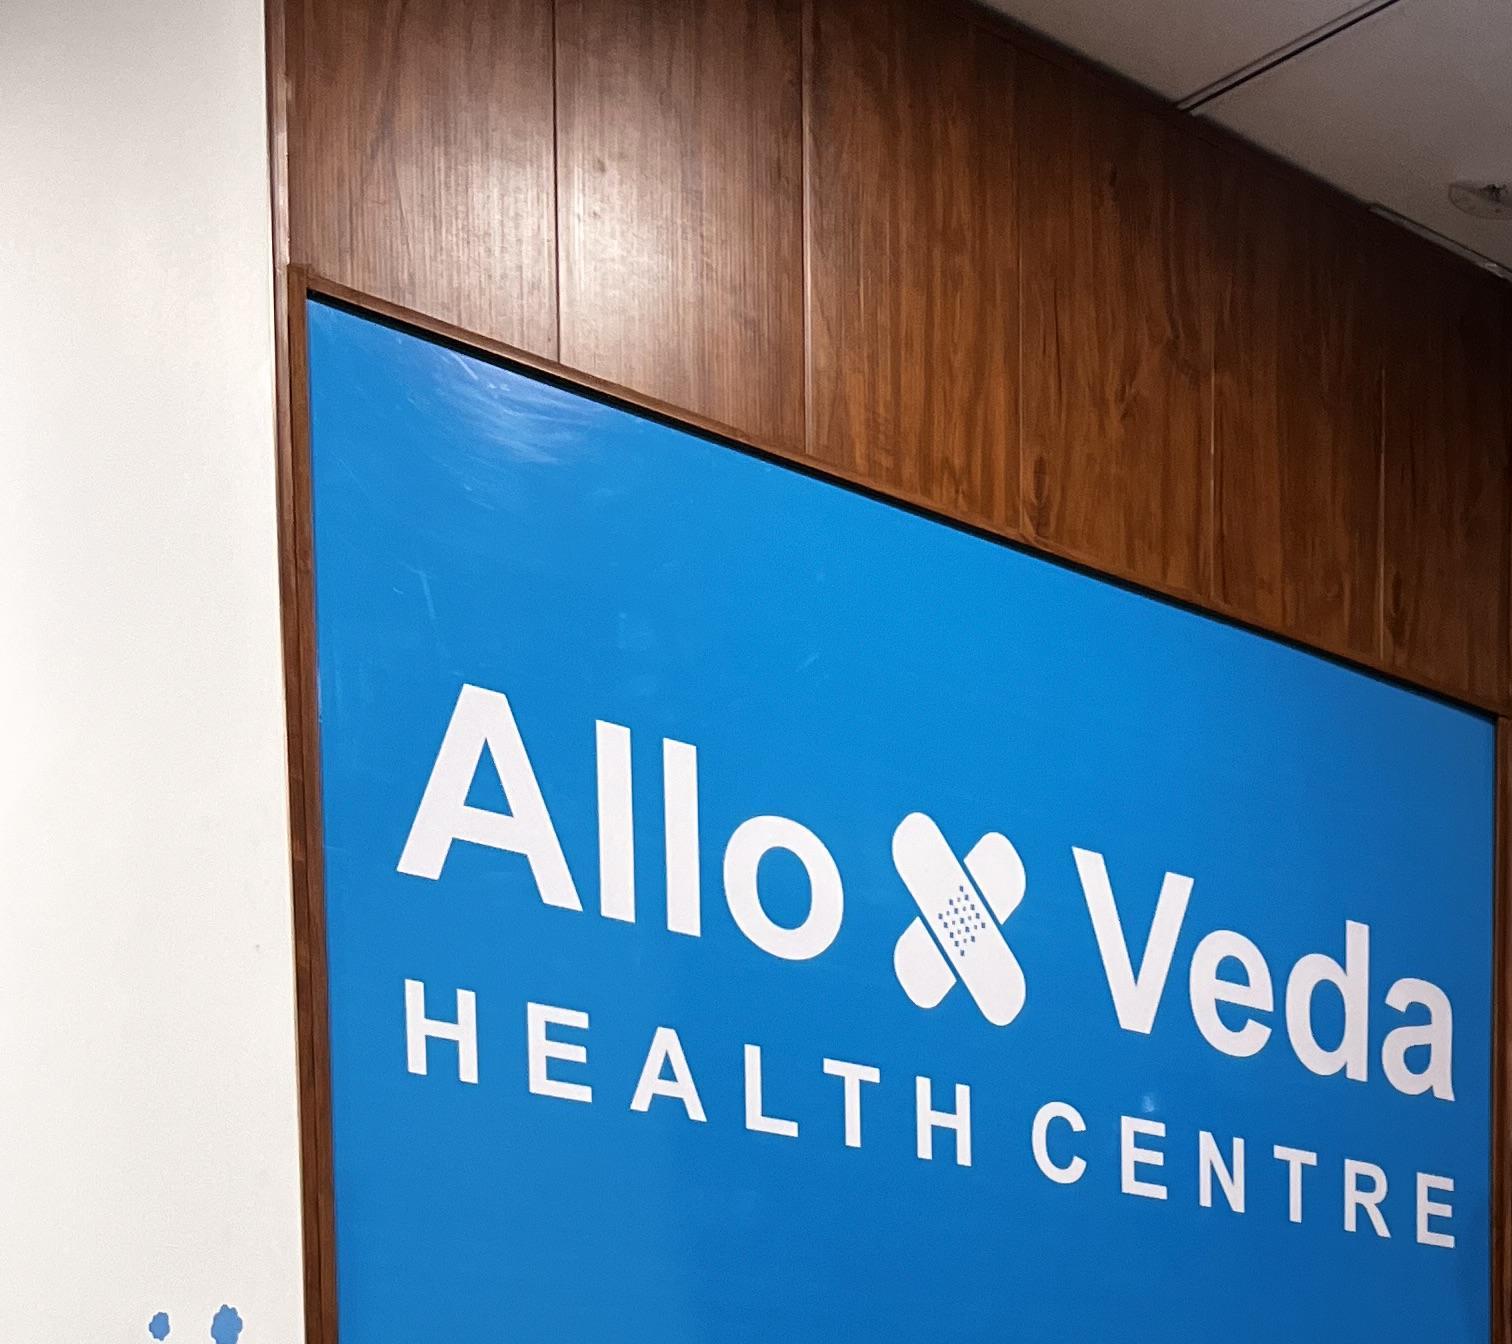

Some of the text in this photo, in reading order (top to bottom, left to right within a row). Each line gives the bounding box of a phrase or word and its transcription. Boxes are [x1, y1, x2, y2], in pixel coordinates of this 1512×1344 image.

[397, 683, 1455, 1102] Allo Veda
[404, 978, 1457, 1249] HEALTH CENTRE
